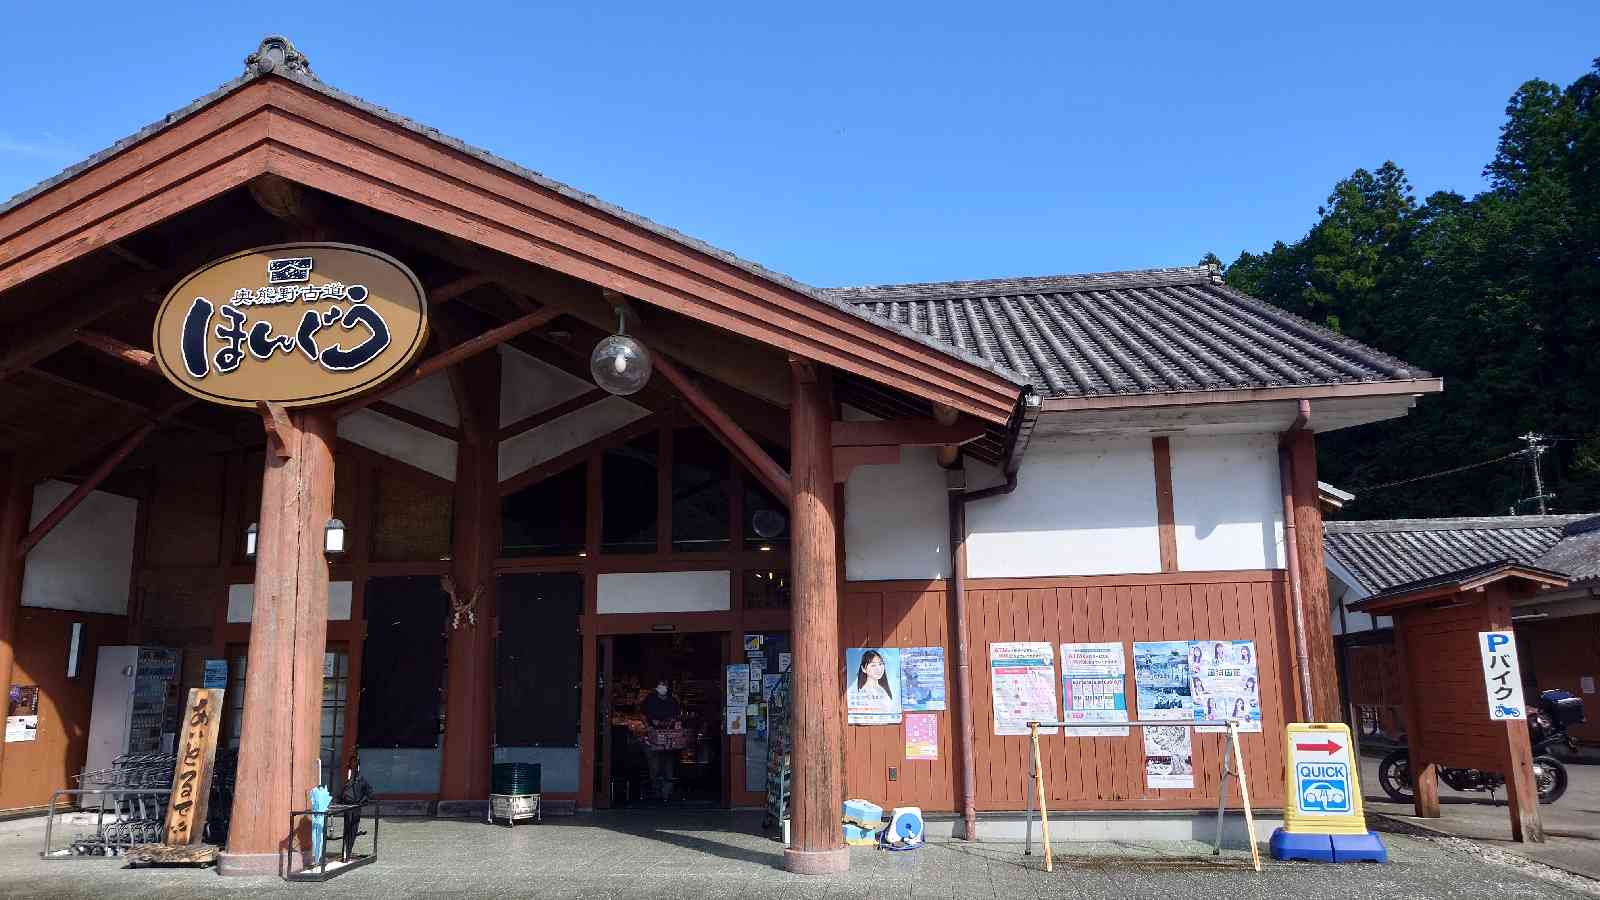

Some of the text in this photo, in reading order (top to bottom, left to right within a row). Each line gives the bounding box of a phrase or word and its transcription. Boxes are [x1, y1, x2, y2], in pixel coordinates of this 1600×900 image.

[231, 283, 346, 305] 奥熊野古道
[181, 285, 391, 378] ほんぐう
[1487, 634, 1509, 652] P
[1490, 654, 1512, 700] バイク
[1301, 767, 1344, 777] QUICK
